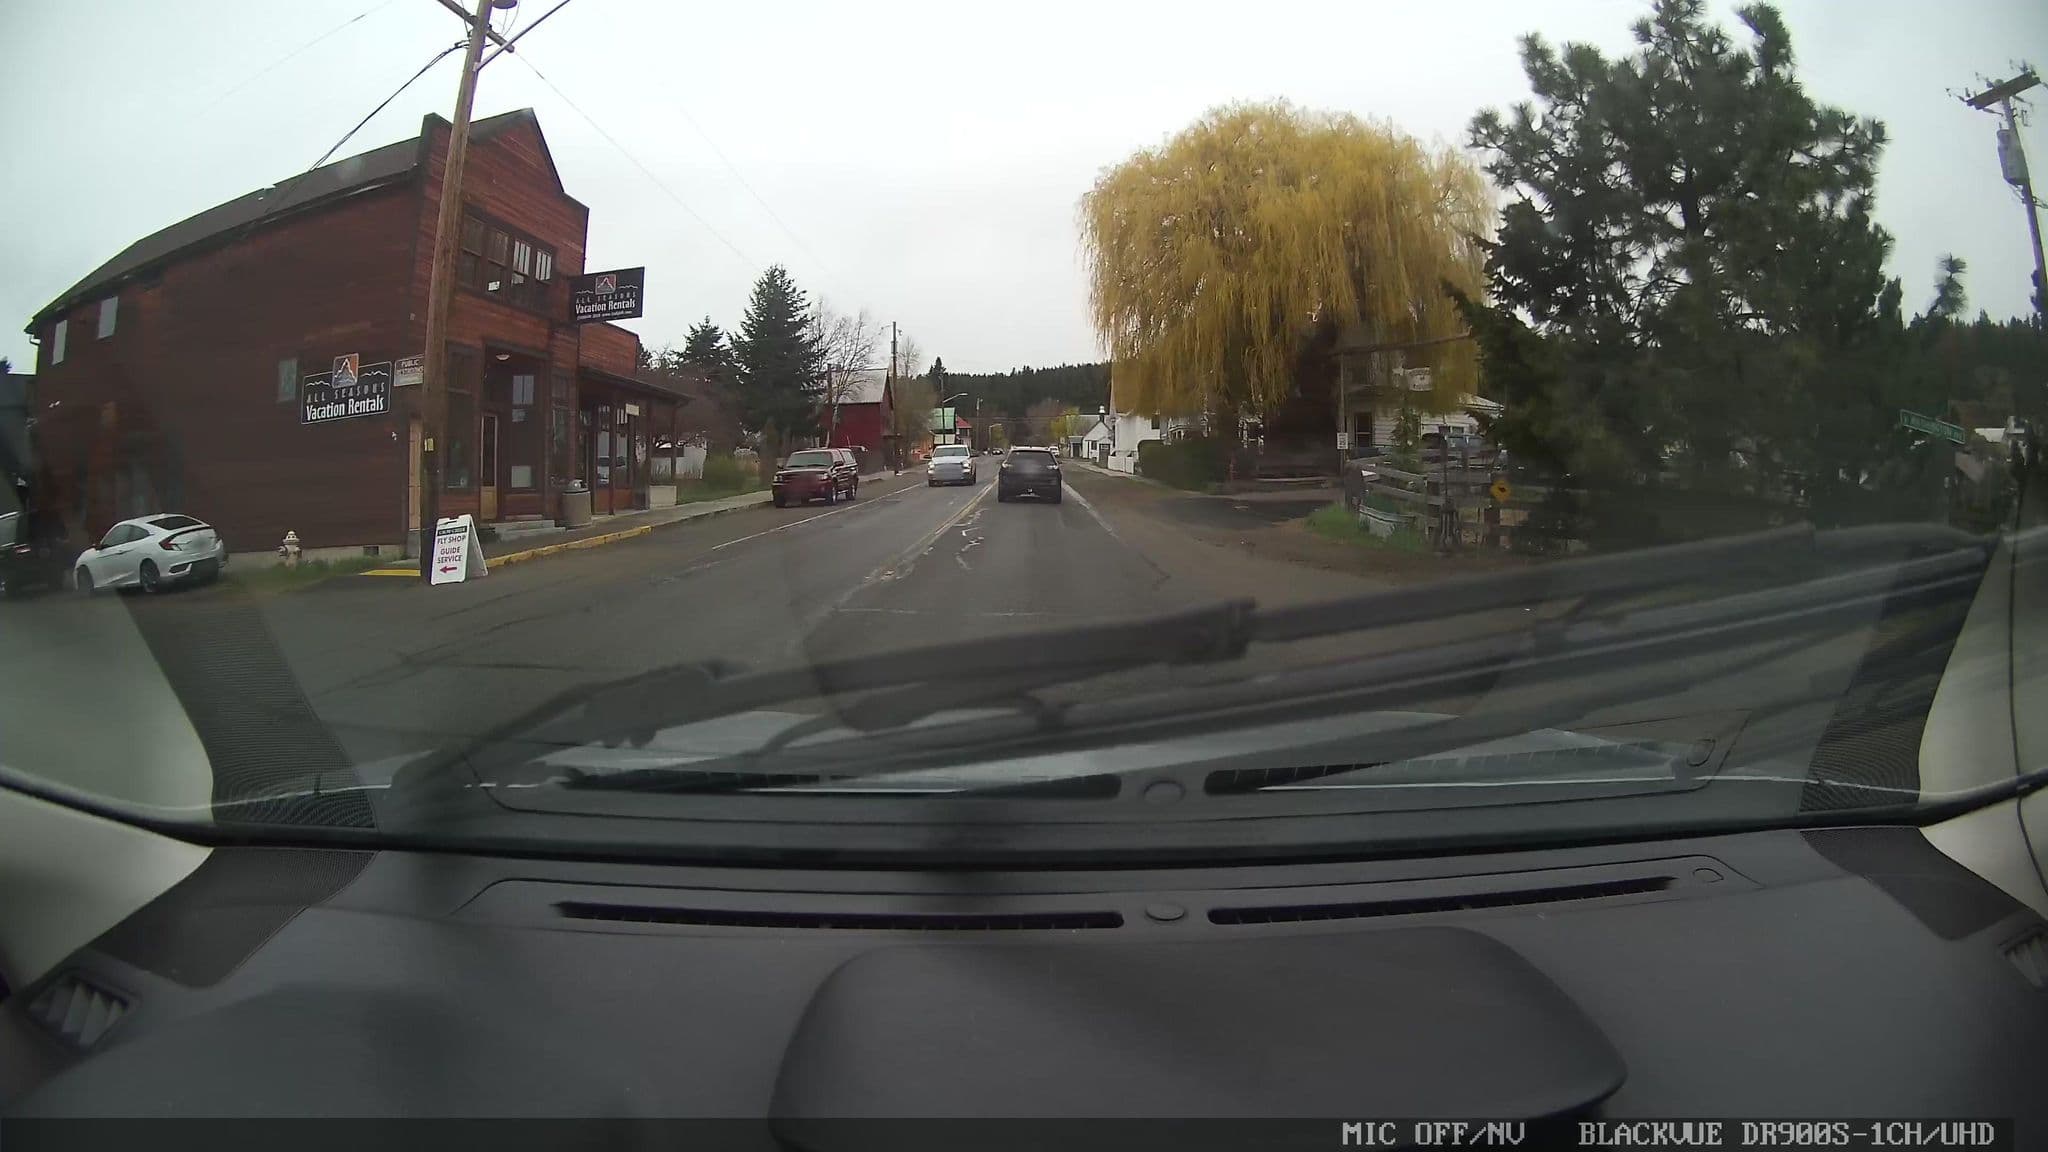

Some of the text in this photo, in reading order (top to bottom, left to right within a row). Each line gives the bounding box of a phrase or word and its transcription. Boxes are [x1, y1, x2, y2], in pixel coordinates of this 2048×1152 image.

[575, 298, 636, 314] Vacation Rentals
[306, 382, 385, 403] ALL SEASONS
[306, 395, 384, 421] Vacation Rentals
[448, 535, 466, 543] SHOP
[440, 547, 461, 555] GUIDE
[437, 555, 463, 563] SERVICE
